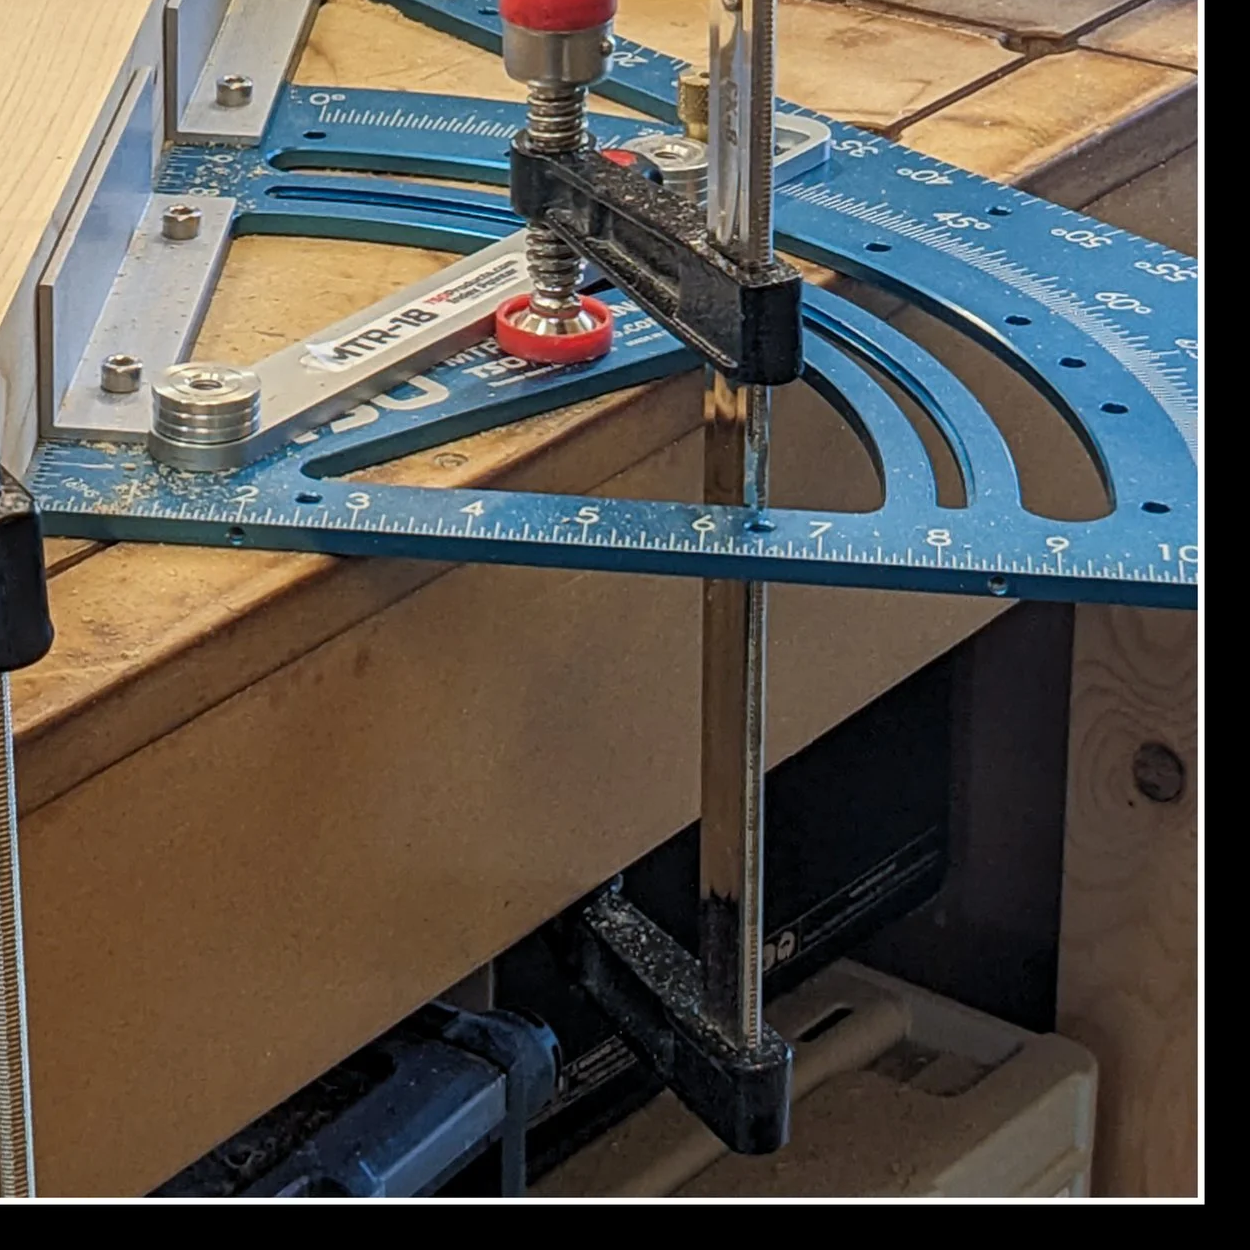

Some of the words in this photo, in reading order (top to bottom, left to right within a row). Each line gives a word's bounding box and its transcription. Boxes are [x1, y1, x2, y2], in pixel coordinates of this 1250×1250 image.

[331, 308, 440, 366] MTR-18
[345, 492, 371, 510] 3
[459, 500, 485, 517] 4
[573, 504, 600, 524] 5
[691, 514, 716, 532] 6
[809, 521, 833, 538] 7
[926, 529, 952, 547] 8
[1045, 536, 1070, 554] 9
[1157, 543, 1198, 563] 10
